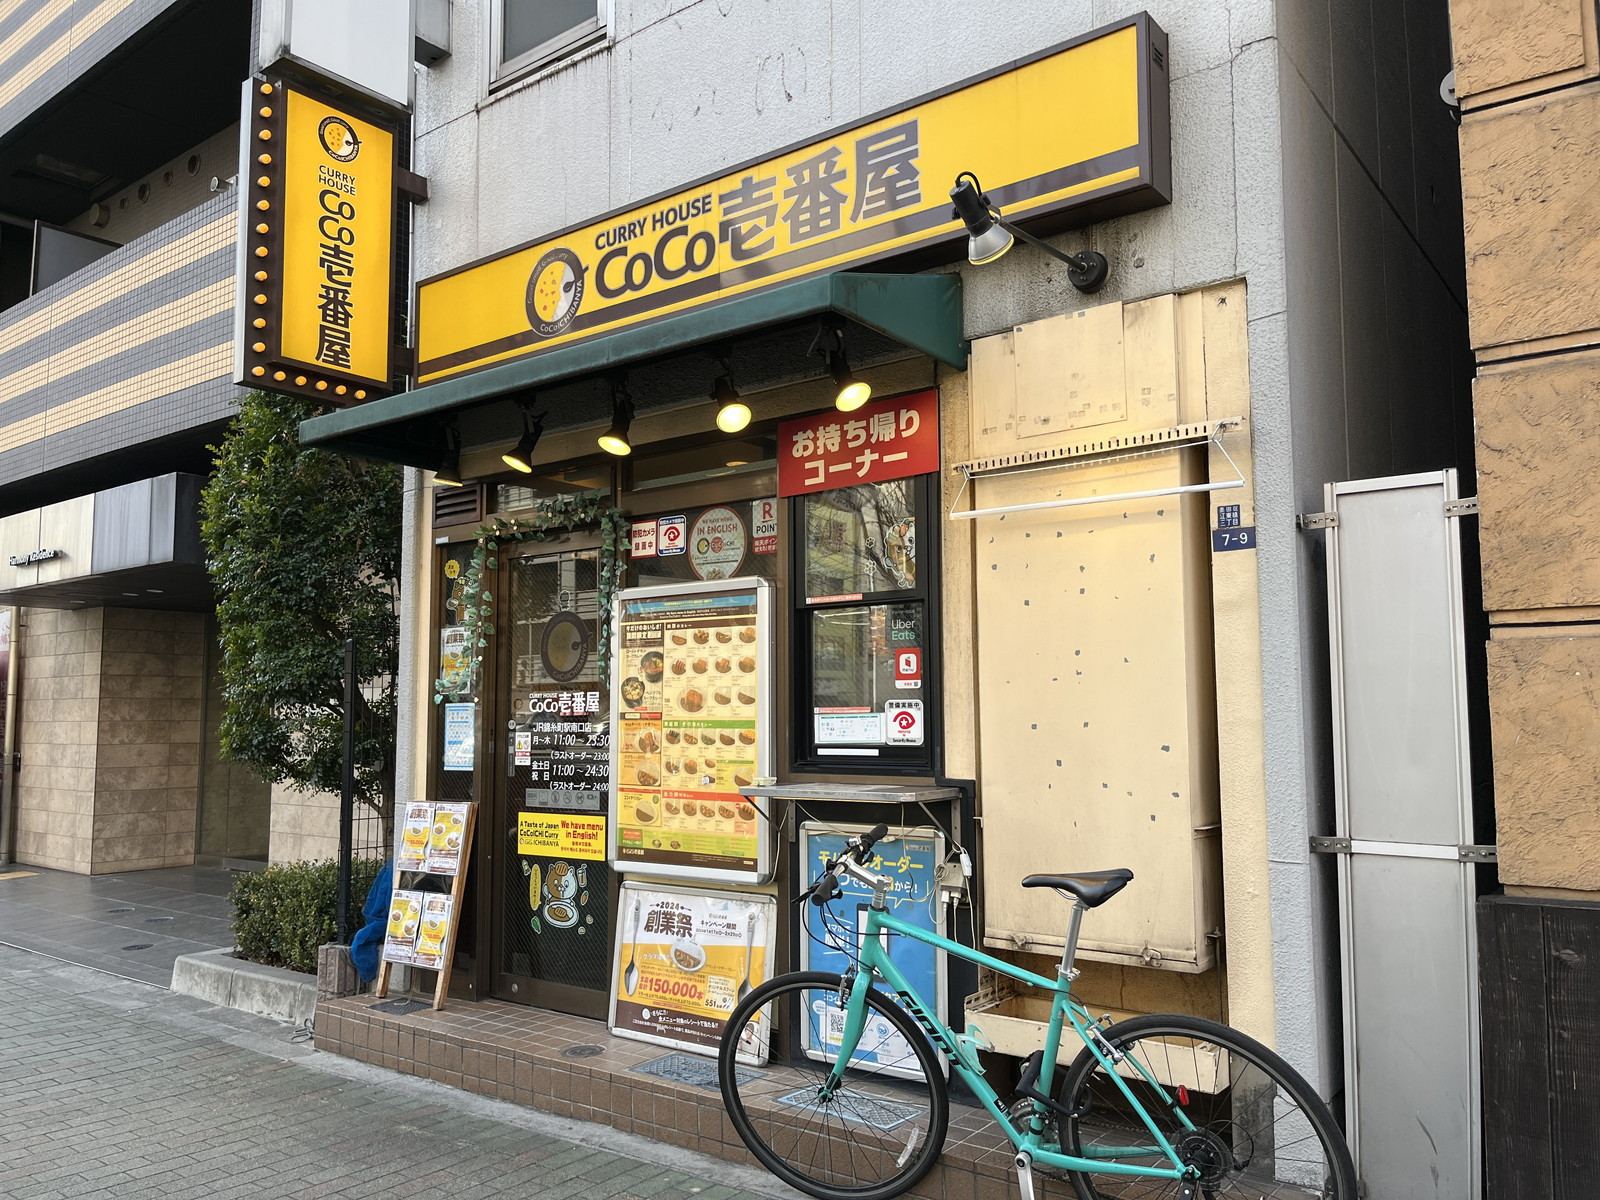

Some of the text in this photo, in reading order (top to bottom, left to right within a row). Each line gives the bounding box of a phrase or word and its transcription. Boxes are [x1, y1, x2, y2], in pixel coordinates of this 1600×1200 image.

[318, 164, 356, 186] CURRY
[318, 174, 356, 197] HOUSE
[595, 192, 713, 251] CURRY HOUSE
[791, 408, 920, 458] お持ち帰り
[804, 448, 908, 486] コーナー
[762, 501, 774, 520] R
[1219, 518, 1239, 526] 三丁目
[697, 524, 738, 535] IN ENGLISH
[1221, 532, 1248, 546] 7-9
[891, 619, 916, 629] Uber
[891, 630, 916, 640] Eats
[529, 691, 600, 713] CoCo壱番屋
[554, 734, 576, 746] 11:00
[586, 734, 610, 747] 23:30
[532, 760, 550, 770] 金土日
[552, 764, 575, 776] 11:00
[584, 764, 610, 777] 24:30
[560, 820, 604, 831] We have menu
[544, 831, 559, 839] Curry
[565, 830, 598, 841] in English!
[660, 901, 680, 911] 2024
[643, 909, 693, 938] 創業祭
[700, 919, 737, 930] キャンペーン期間
[648, 976, 704, 1001] 150,000本
[895, 990, 972, 1072] GIANT
